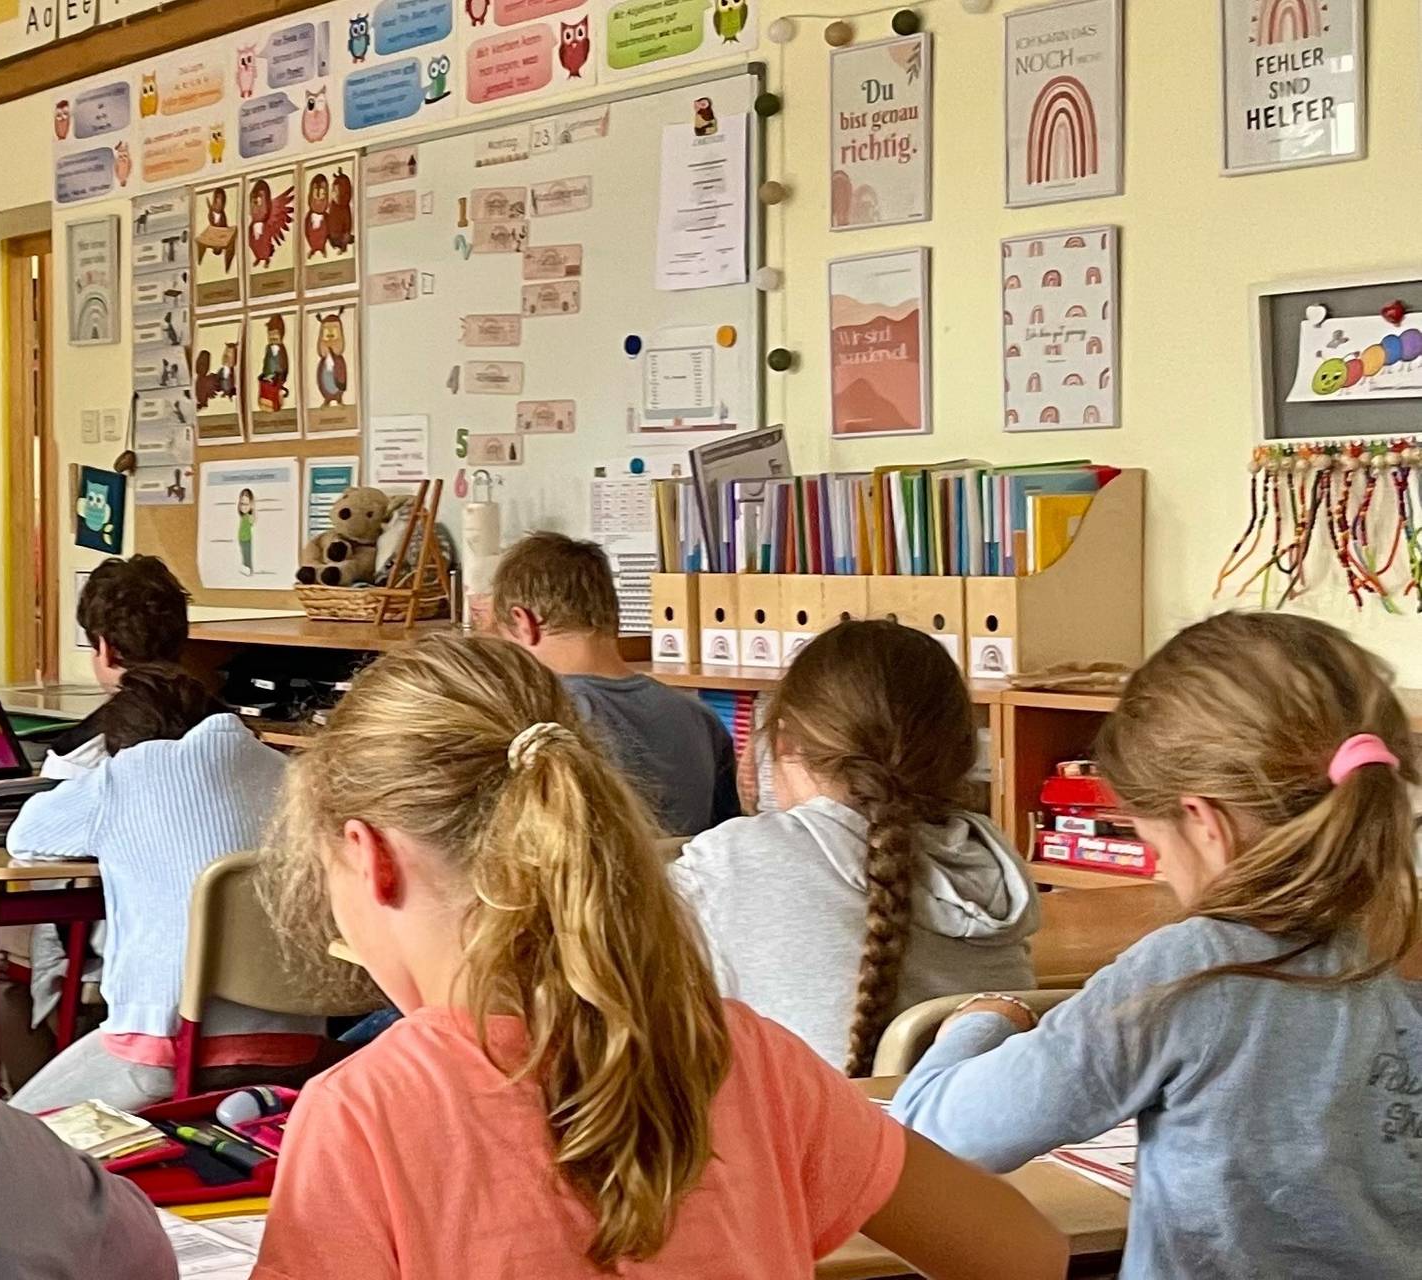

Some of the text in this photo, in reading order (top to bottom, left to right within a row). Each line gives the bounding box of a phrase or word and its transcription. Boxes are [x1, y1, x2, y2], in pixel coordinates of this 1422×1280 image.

[1016, 47, 1074, 75] NOCH
[1256, 47, 1324, 77] FEHLER
[861, 78, 894, 104] Du
[1269, 77, 1311, 99] SIND
[840, 105, 919, 131] bist genau
[1246, 96, 1336, 130] HELFER
[840, 132, 918, 164] richtig.
[458, 197, 468, 228] 1
[456, 428, 468, 458] 5
